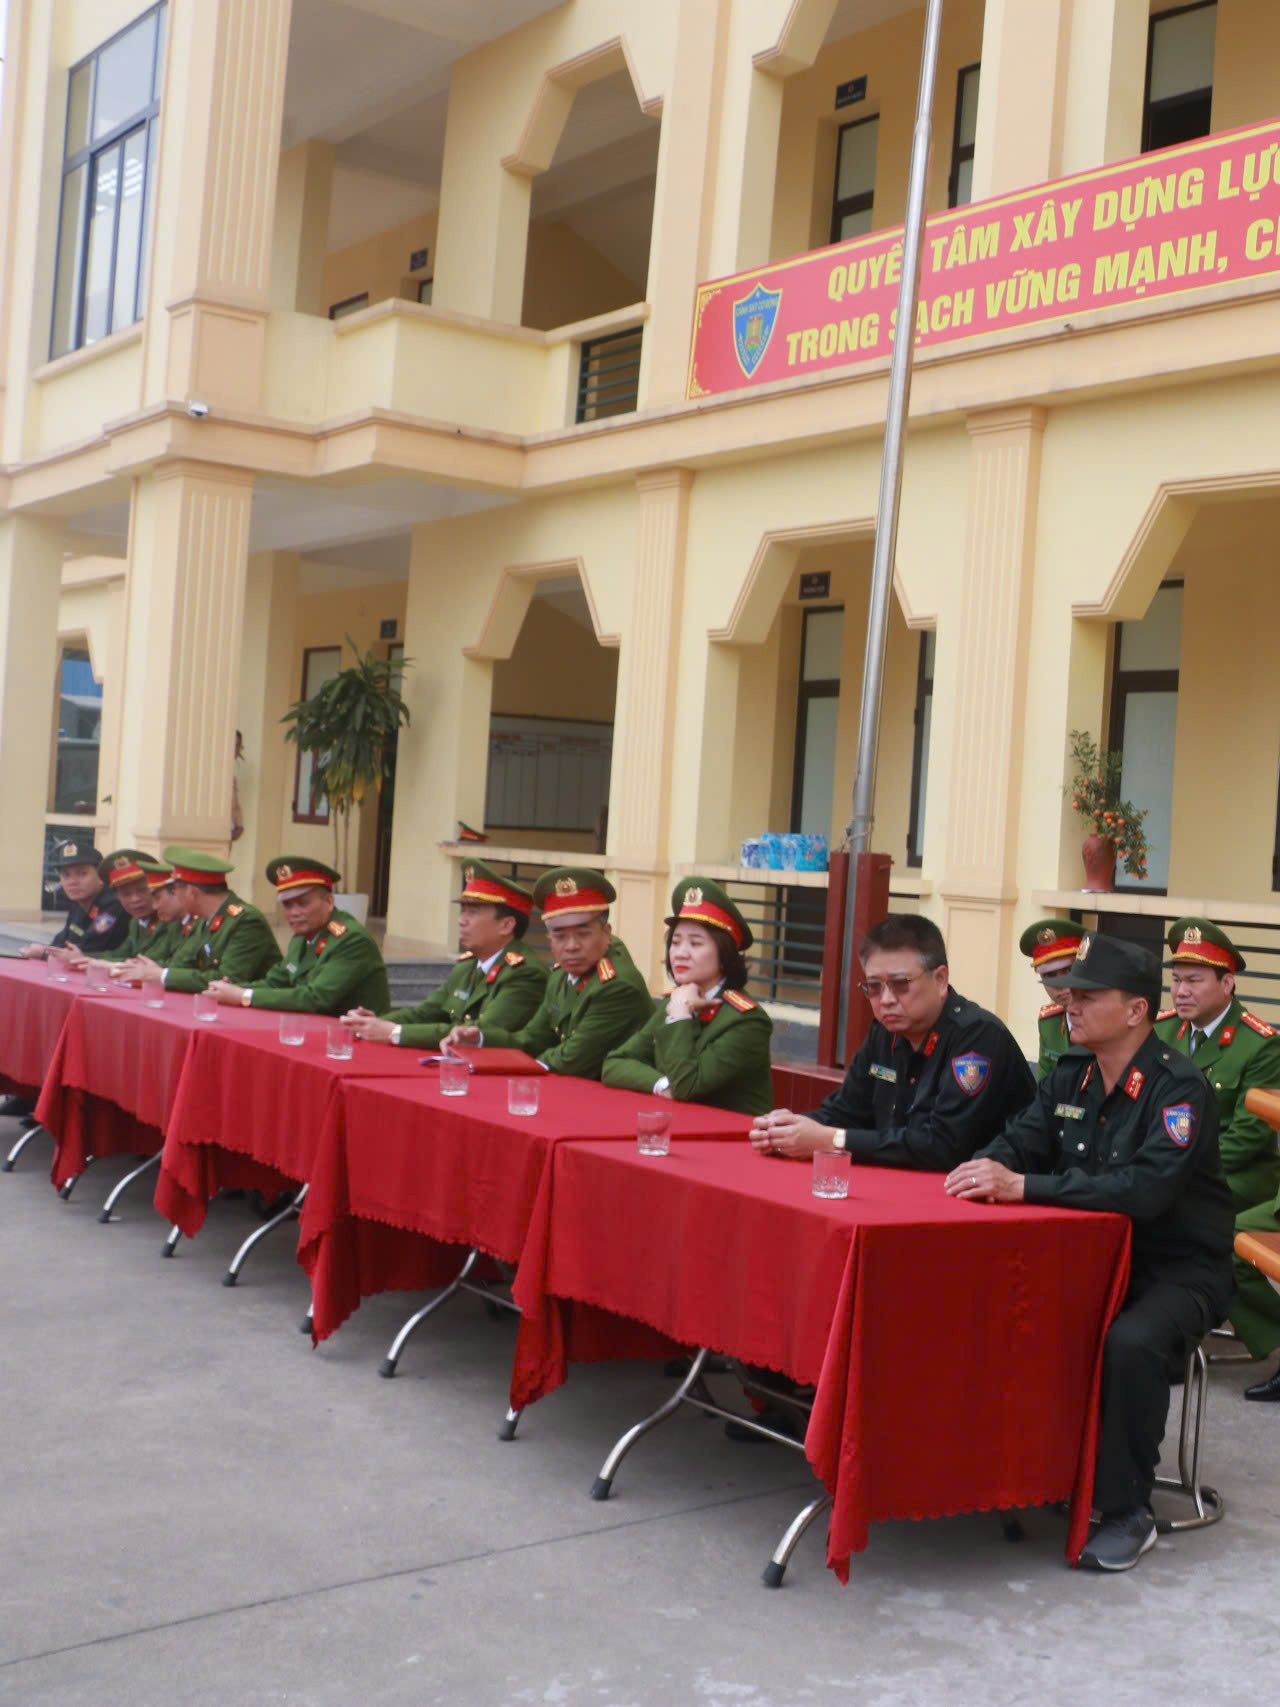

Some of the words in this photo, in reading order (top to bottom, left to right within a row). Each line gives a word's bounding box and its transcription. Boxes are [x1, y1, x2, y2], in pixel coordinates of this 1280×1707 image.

[787, 313, 880, 365] TRONG
[985, 264, 1082, 318] VỮNG
[1092, 230, 1228, 295] MẠNH,
[827, 237, 904, 302] QUYẾ
[930, 221, 1001, 273] TÂM
[1010, 198, 1083, 253] XÂY
[1092, 167, 1204, 231] DỰNG
